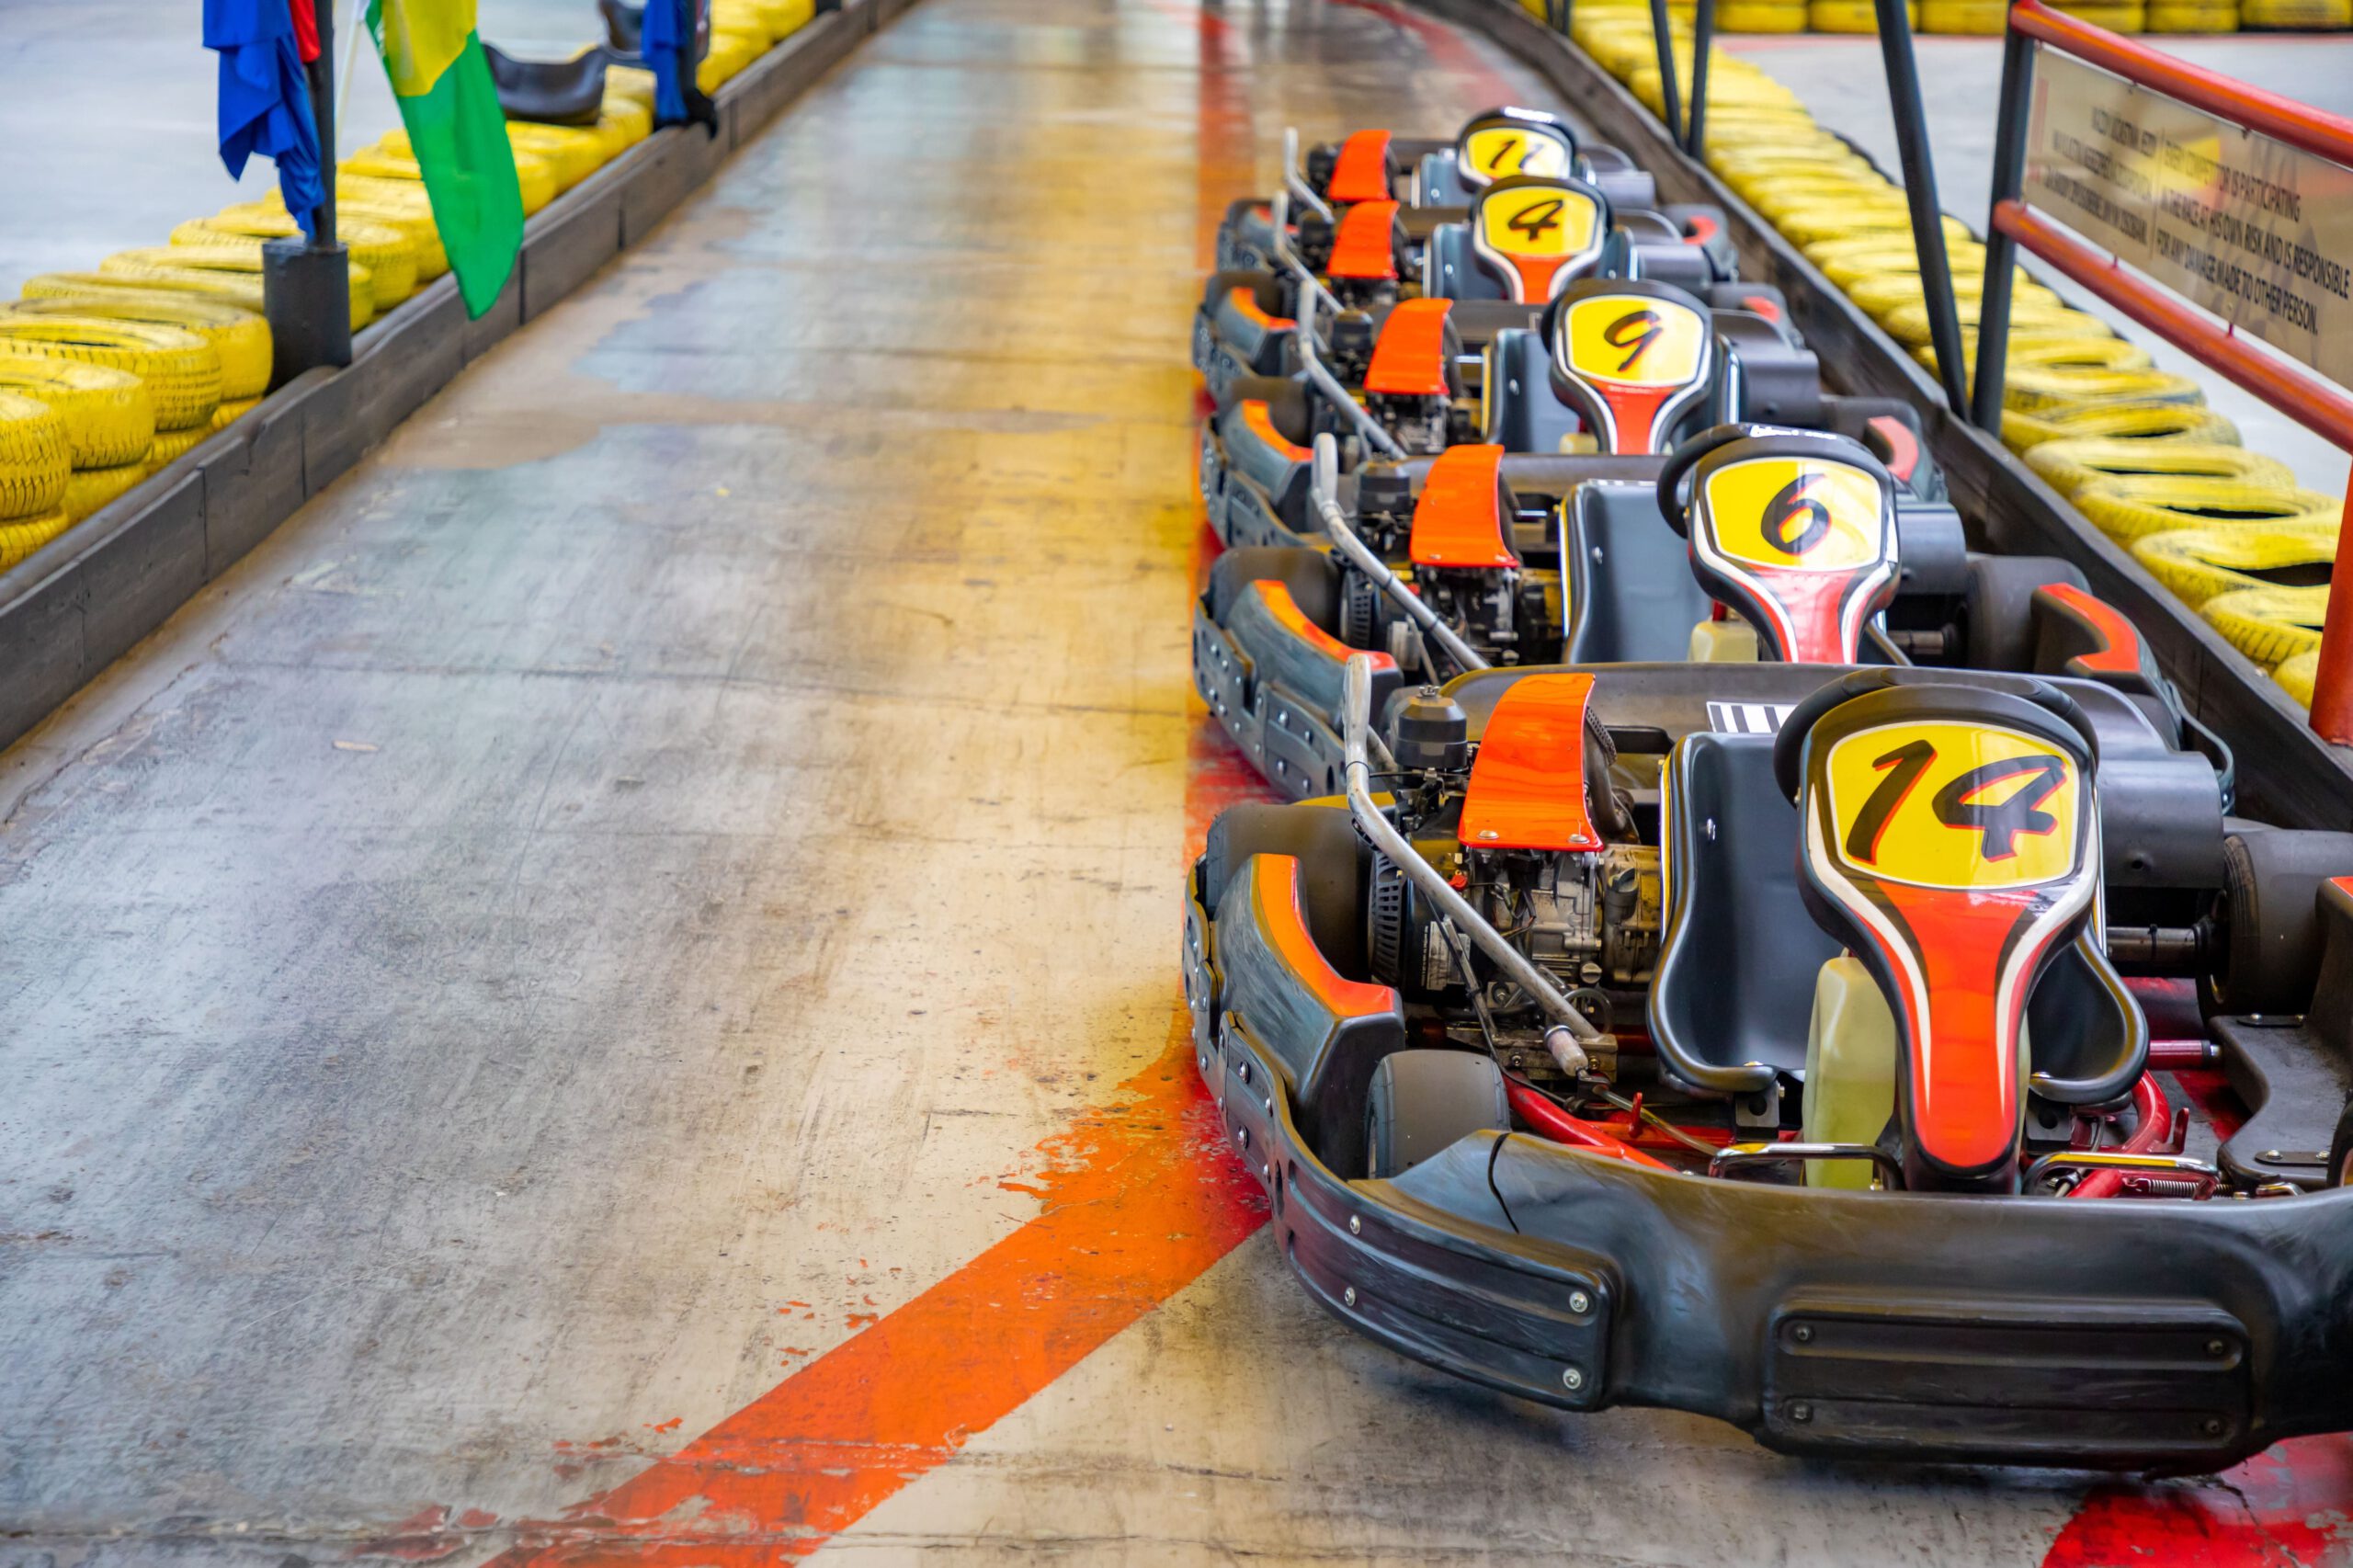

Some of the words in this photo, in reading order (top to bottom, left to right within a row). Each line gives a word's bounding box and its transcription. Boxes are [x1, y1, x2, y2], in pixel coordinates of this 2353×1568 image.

[1507, 199, 1563, 243] 4
[2241, 170, 2301, 223] PARTICIPATING
[2185, 244, 2216, 284] DAMAGE
[2216, 260, 2241, 296] MADE
[2242, 270, 2253, 302] TO
[2254, 277, 2282, 316] OTHER
[2283, 290, 2319, 336] PERSON.
[2222, 212, 2243, 248] OWN
[2245, 223, 2264, 256] RISK
[2264, 232, 2283, 266] AND
[2284, 241, 2292, 270] IS
[2293, 244, 2350, 301] RESPONSIBLE
[1603, 310, 1664, 373] 9
[1761, 473, 1832, 557] 6
[1846, 739, 2067, 866] 14
